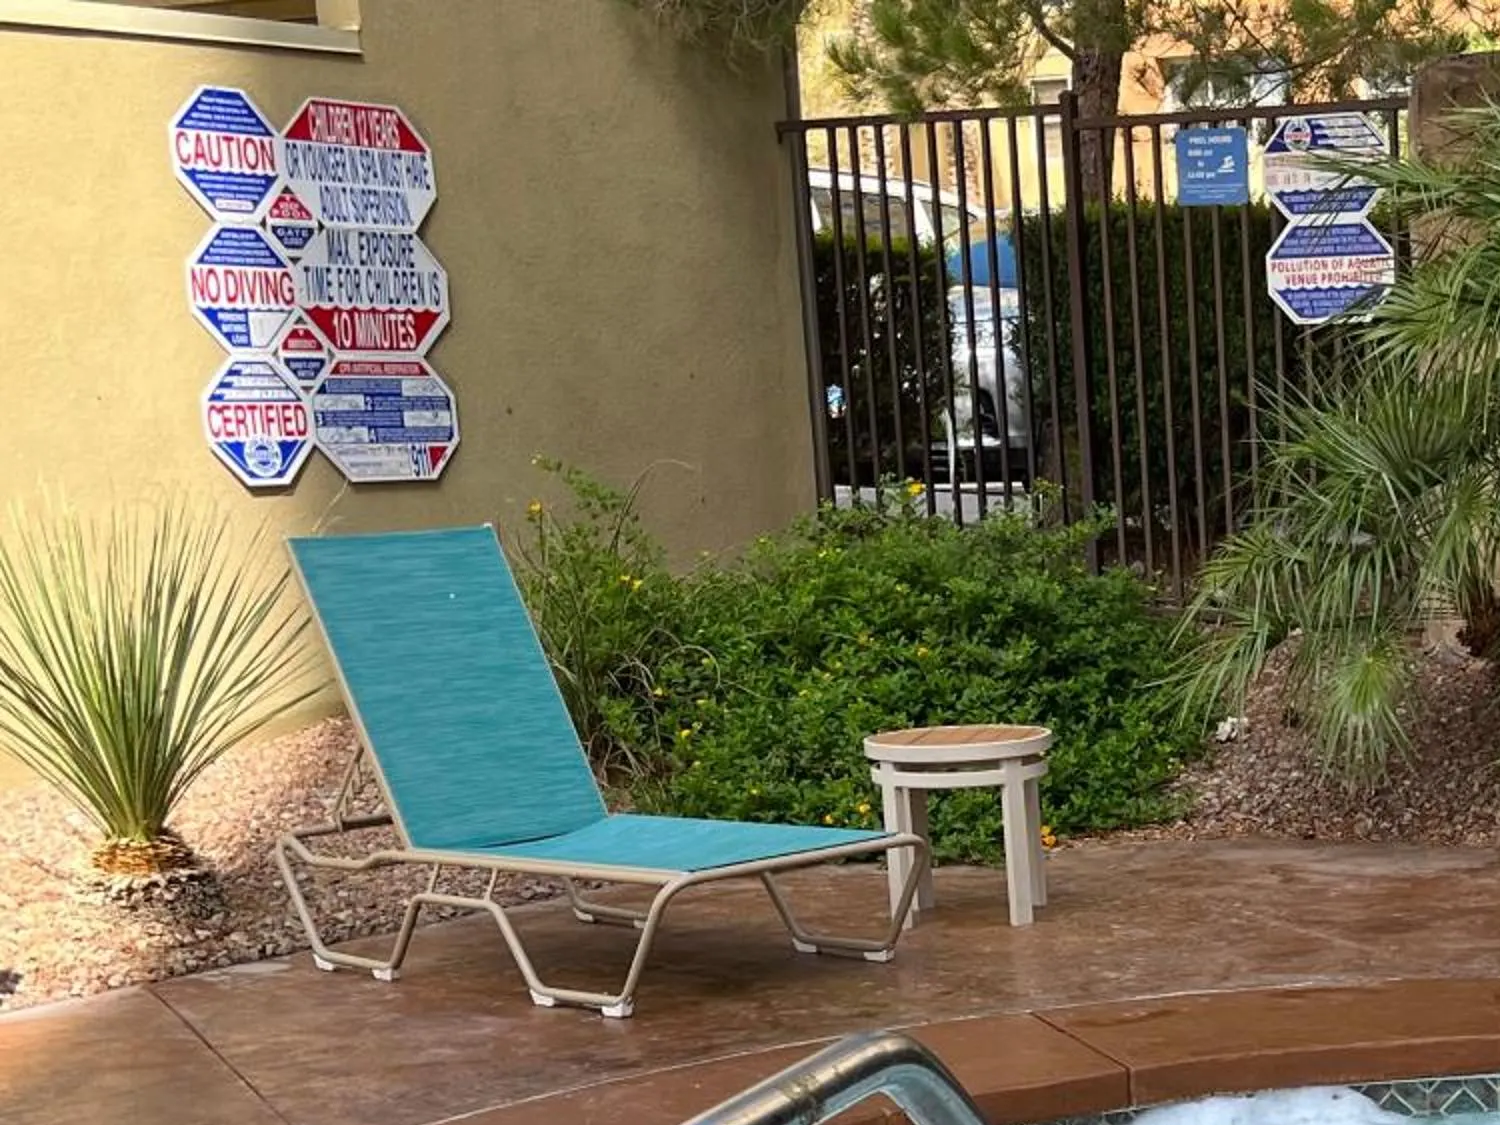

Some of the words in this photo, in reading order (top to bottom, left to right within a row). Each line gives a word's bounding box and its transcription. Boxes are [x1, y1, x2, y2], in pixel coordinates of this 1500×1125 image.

[308, 104, 356, 144] CHILDREN
[357, 110, 369, 146] 12
[368, 110, 401, 148] YEARS
[175, 131, 276, 171] CAUTION
[285, 142, 302, 179] OR
[301, 143, 349, 183] YOUNGER
[347, 148, 359, 184] IN
[359, 149, 379, 185] SPA
[379, 150, 404, 188] MUST
[404, 153, 431, 191] HAVE
[320, 183, 349, 222] ADULT
[276, 228, 309, 237] GATE
[358, 232, 415, 268] EXPOSURE
[1271, 260, 1329, 273] POLLUTION
[1331, 260, 1344, 271] OF
[1285, 272, 1319, 285] VENUE
[191, 268, 221, 304] NO
[223, 270, 295, 306] DIVING
[303, 267, 335, 303] TIME
[336, 268, 363, 304] FOR
[366, 270, 426, 306] CHILDREN
[429, 272, 441, 307] IS
[333, 312, 353, 348] 10
[354, 313, 418, 350] MINUTES
[207, 404, 308, 437] CERTIFIED
